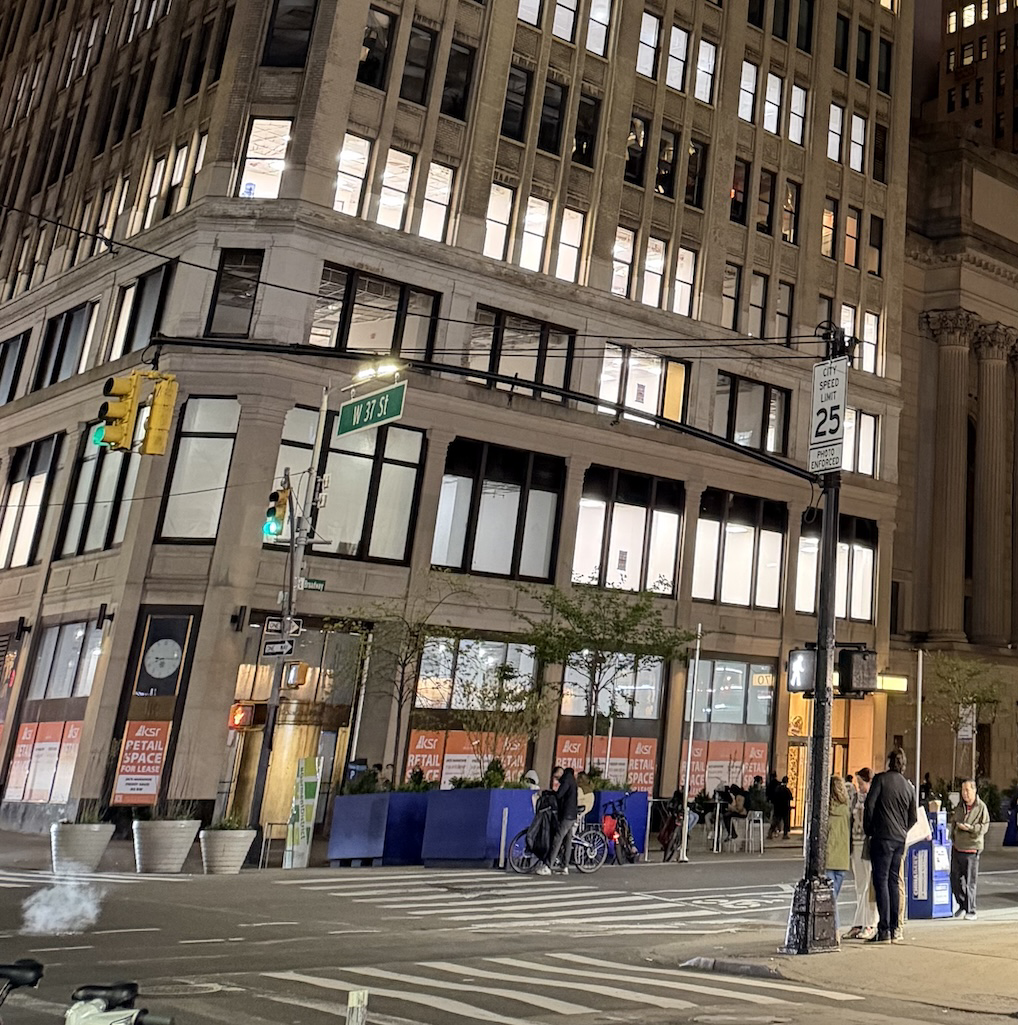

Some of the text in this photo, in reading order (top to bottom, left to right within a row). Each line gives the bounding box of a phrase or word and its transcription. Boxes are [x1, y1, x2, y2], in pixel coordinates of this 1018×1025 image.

[822, 364, 838, 377] CITY
[819, 377, 839, 391] SPEED
[820, 390, 837, 403] LIMIT
[352, 394, 390, 426] W 37 St
[814, 404, 841, 438] 25
[817, 448, 835, 459] PHOTO
[811, 456, 840, 470] ENFORCED
[125, 739, 163, 751] RETAIL
[122, 752, 162, 764] SPACE
[408, 754, 440, 768] RETAIL
[628, 758, 654, 771] RETAIL
[120, 764, 160, 773] FOR LEASE
[743, 761, 766, 774] RETAIL
[627, 772, 654, 785] SPACE
